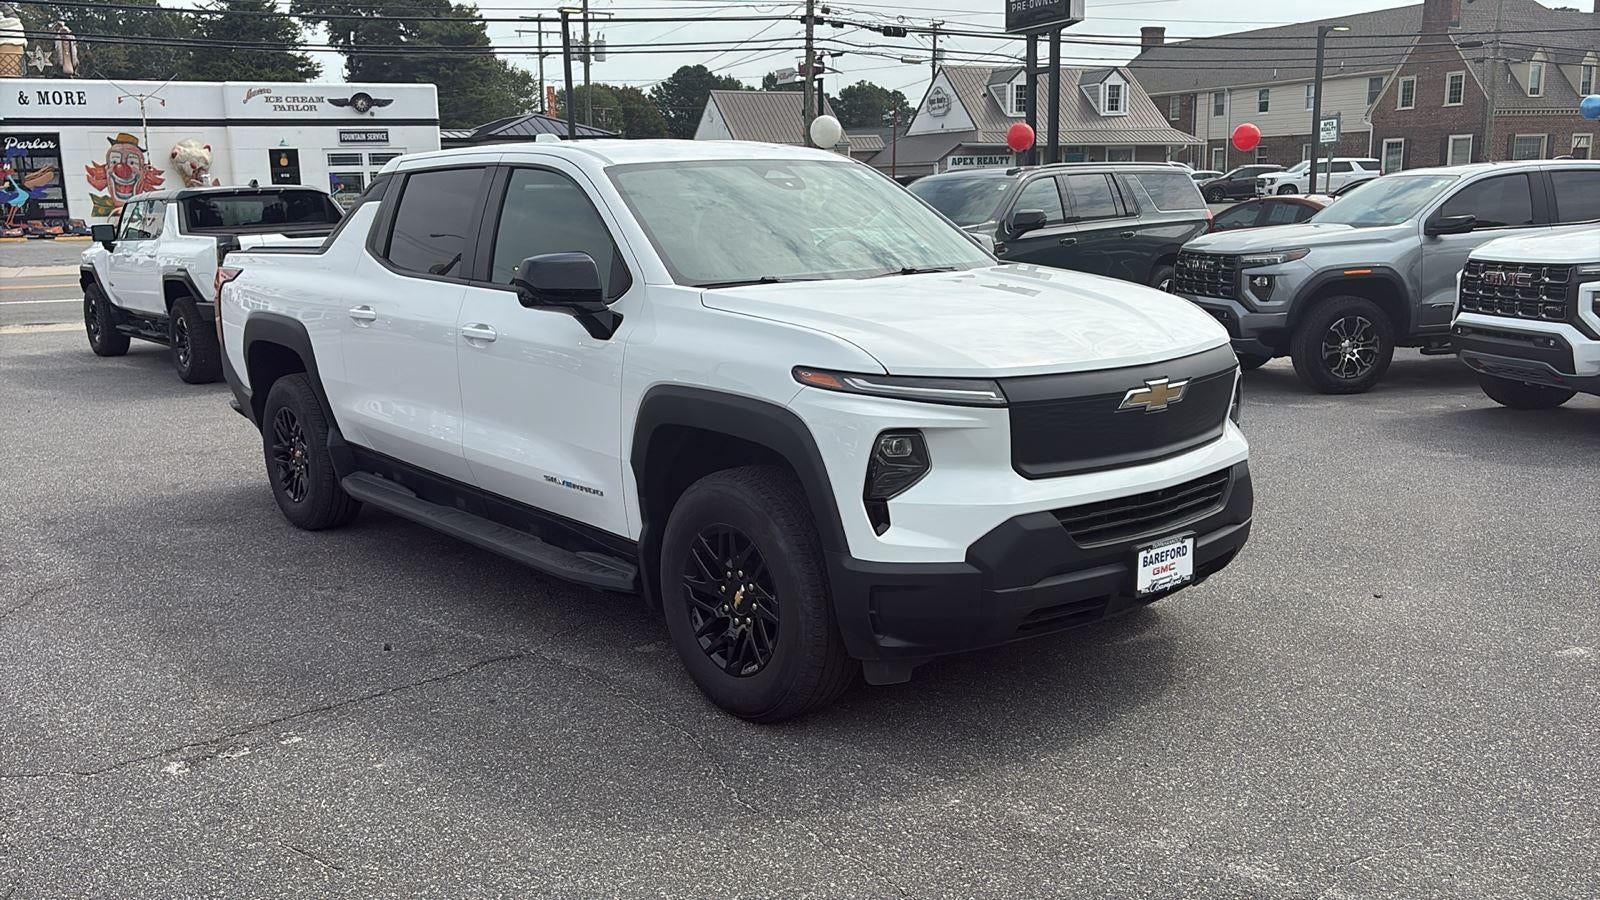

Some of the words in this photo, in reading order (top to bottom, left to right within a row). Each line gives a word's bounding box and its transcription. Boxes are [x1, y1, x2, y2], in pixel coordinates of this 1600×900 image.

[18, 90, 30, 106] &
[36, 90, 87, 106] MORE
[273, 104, 318, 112] PARLOR
[341, 132, 366, 140] FOUNTAIN
[367, 132, 387, 140] SERVICE
[4, 136, 57, 150] Parlor
[951, 157, 975, 166] APEX
[976, 156, 1010, 165] REALTY
[1482, 270, 1532, 288] GMC
[1143, 545, 1188, 567] BAREFORD
[1152, 562, 1176, 575] GMC
